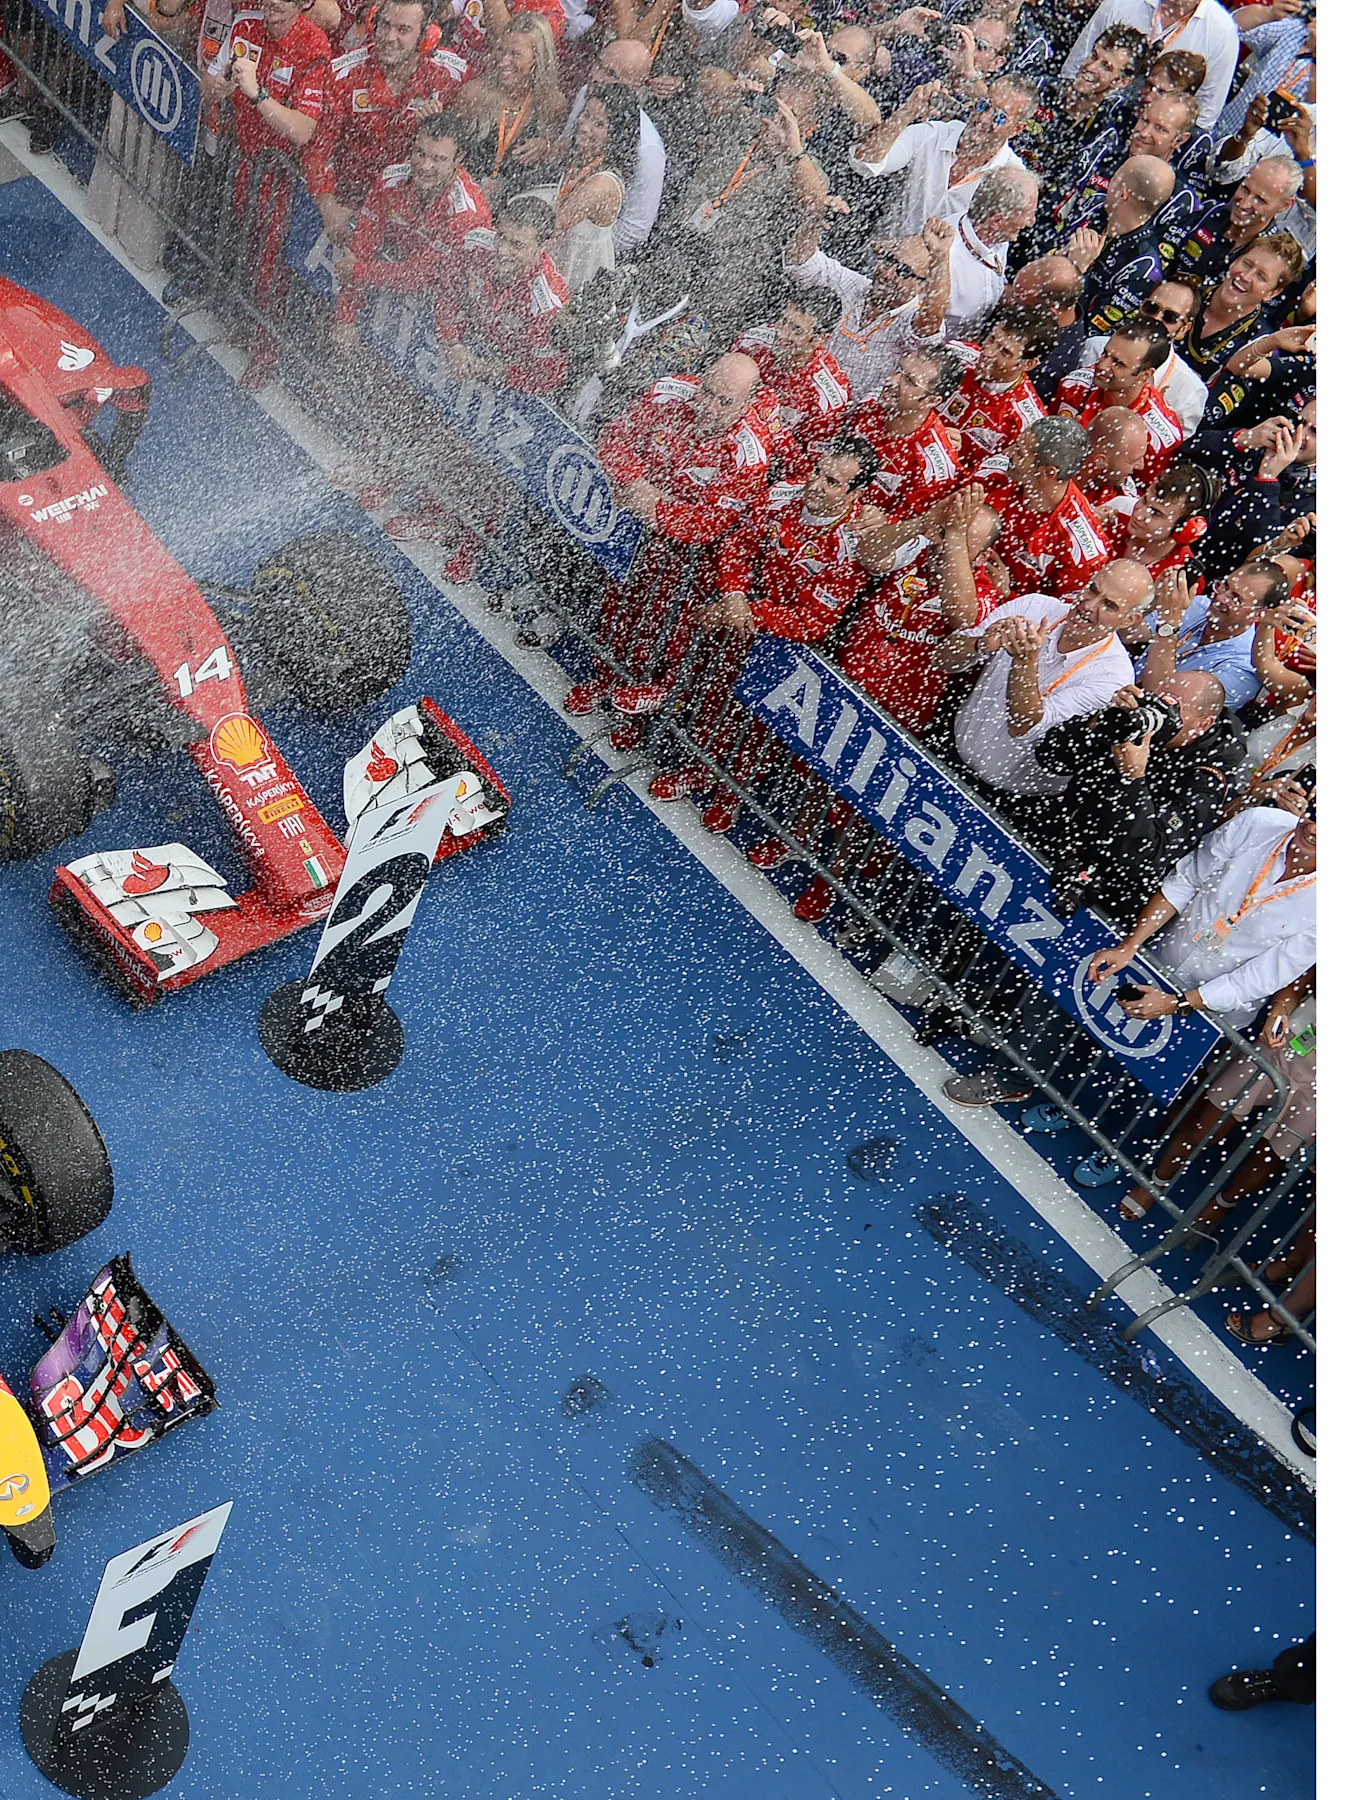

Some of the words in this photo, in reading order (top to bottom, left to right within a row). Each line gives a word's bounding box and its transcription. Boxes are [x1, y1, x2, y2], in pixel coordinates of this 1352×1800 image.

[30, 484, 108, 523] WEICHAI
[1073, 519, 1095, 557] KASPERSKY
[173, 645, 233, 698] 14
[239, 763, 277, 787] TNT
[205, 770, 261, 850] KASPERSKY
[264, 798, 299, 820] PIRELLI
[277, 814, 306, 839] FIAT
[759, 656, 1065, 965] Allianz
[324, 851, 431, 968] 2
